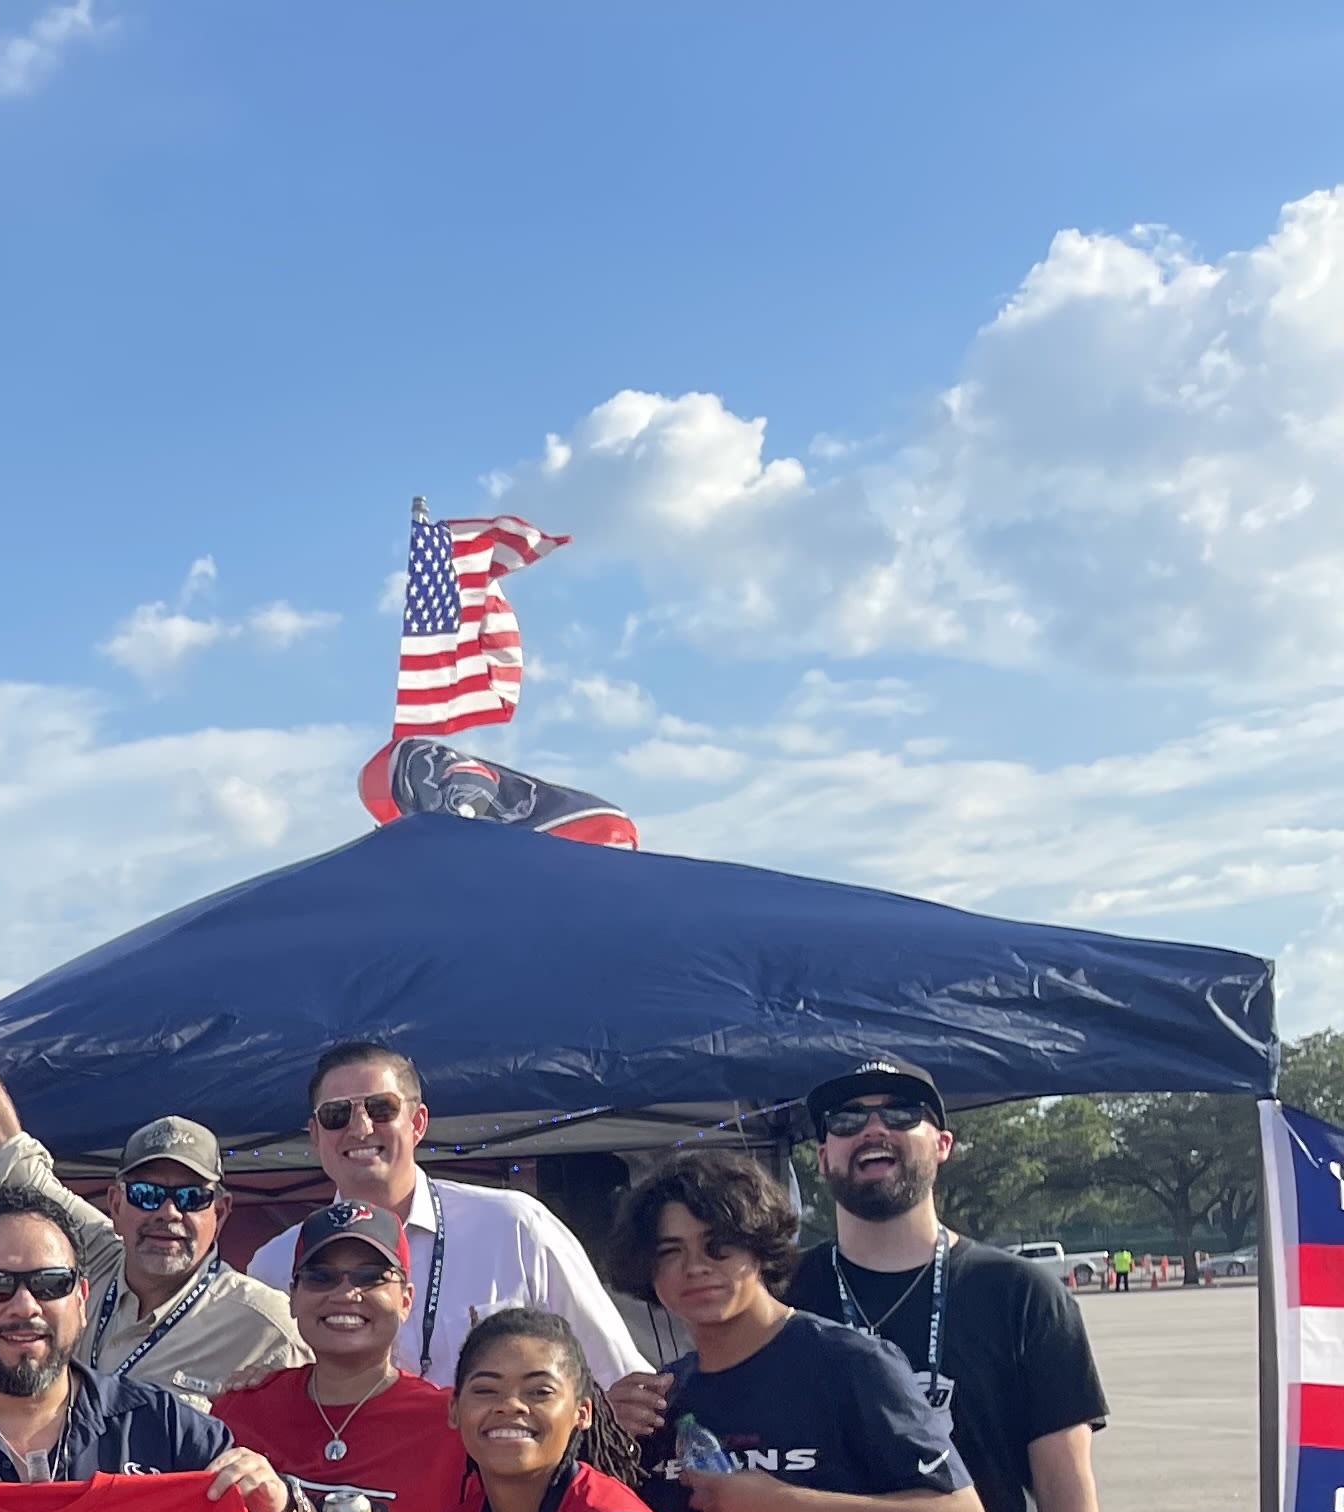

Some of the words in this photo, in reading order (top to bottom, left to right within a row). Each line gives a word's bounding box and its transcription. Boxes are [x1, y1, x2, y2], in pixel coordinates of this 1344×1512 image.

[165, 1282, 208, 1326] TEXANS
[428, 1259, 442, 1313] TEXANS
[927, 1311, 940, 1364] TEXANS
